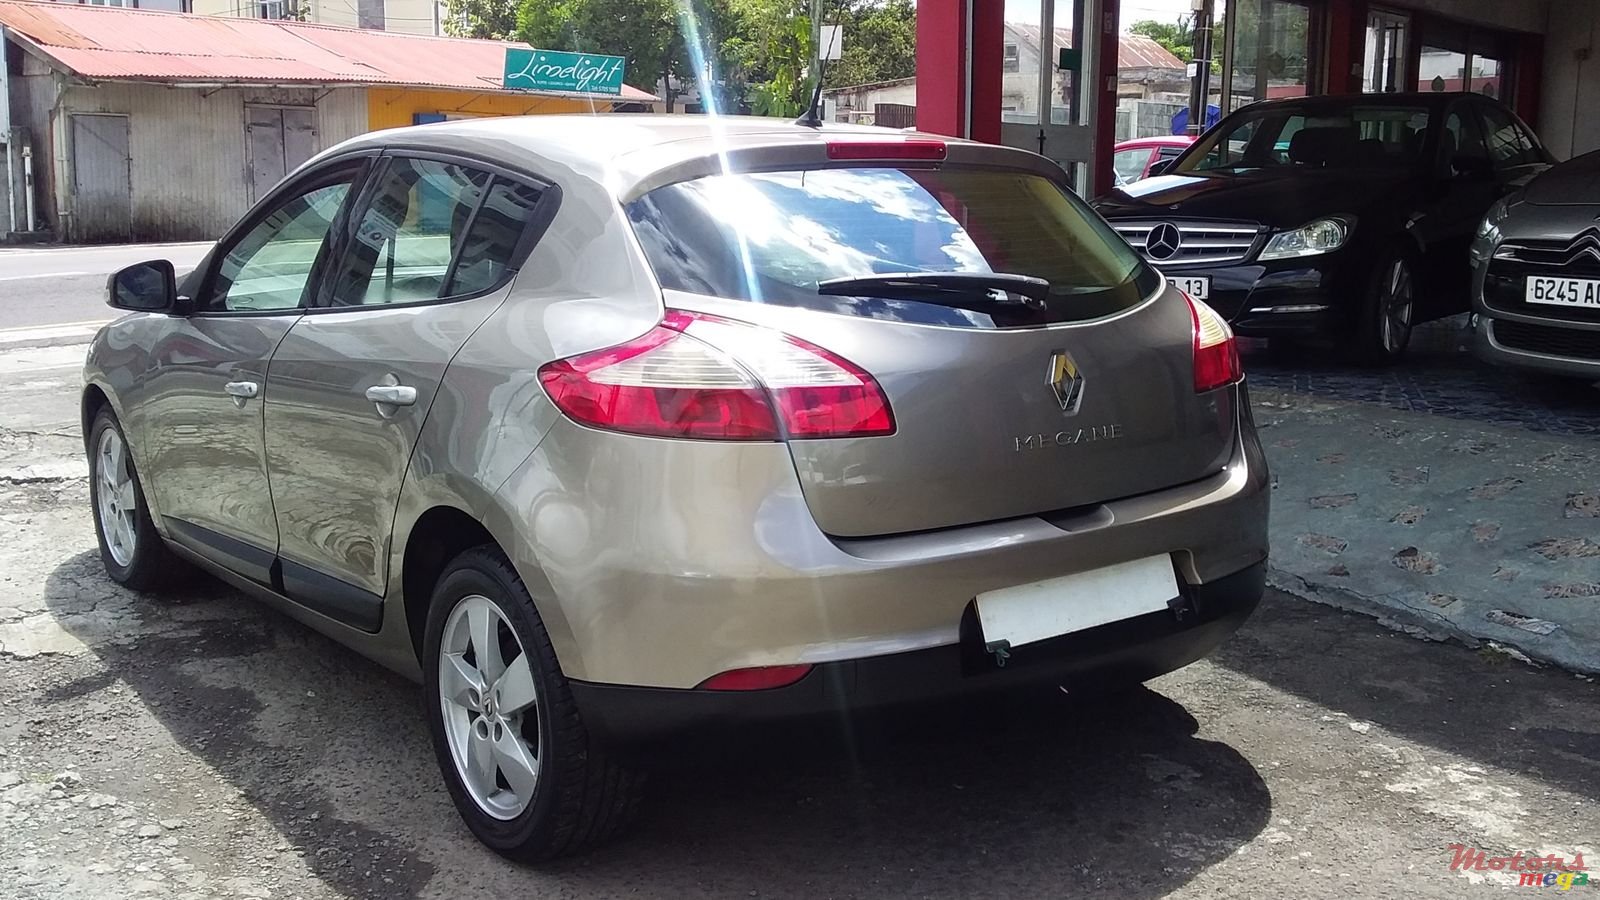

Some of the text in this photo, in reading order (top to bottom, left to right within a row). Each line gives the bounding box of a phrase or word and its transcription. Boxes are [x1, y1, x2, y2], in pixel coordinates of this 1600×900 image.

[507, 52, 622, 91] Limelight
[1185, 279, 1203, 297] 13
[1534, 278, 1579, 303] 6245
[1015, 424, 1123, 451] MEGANE
